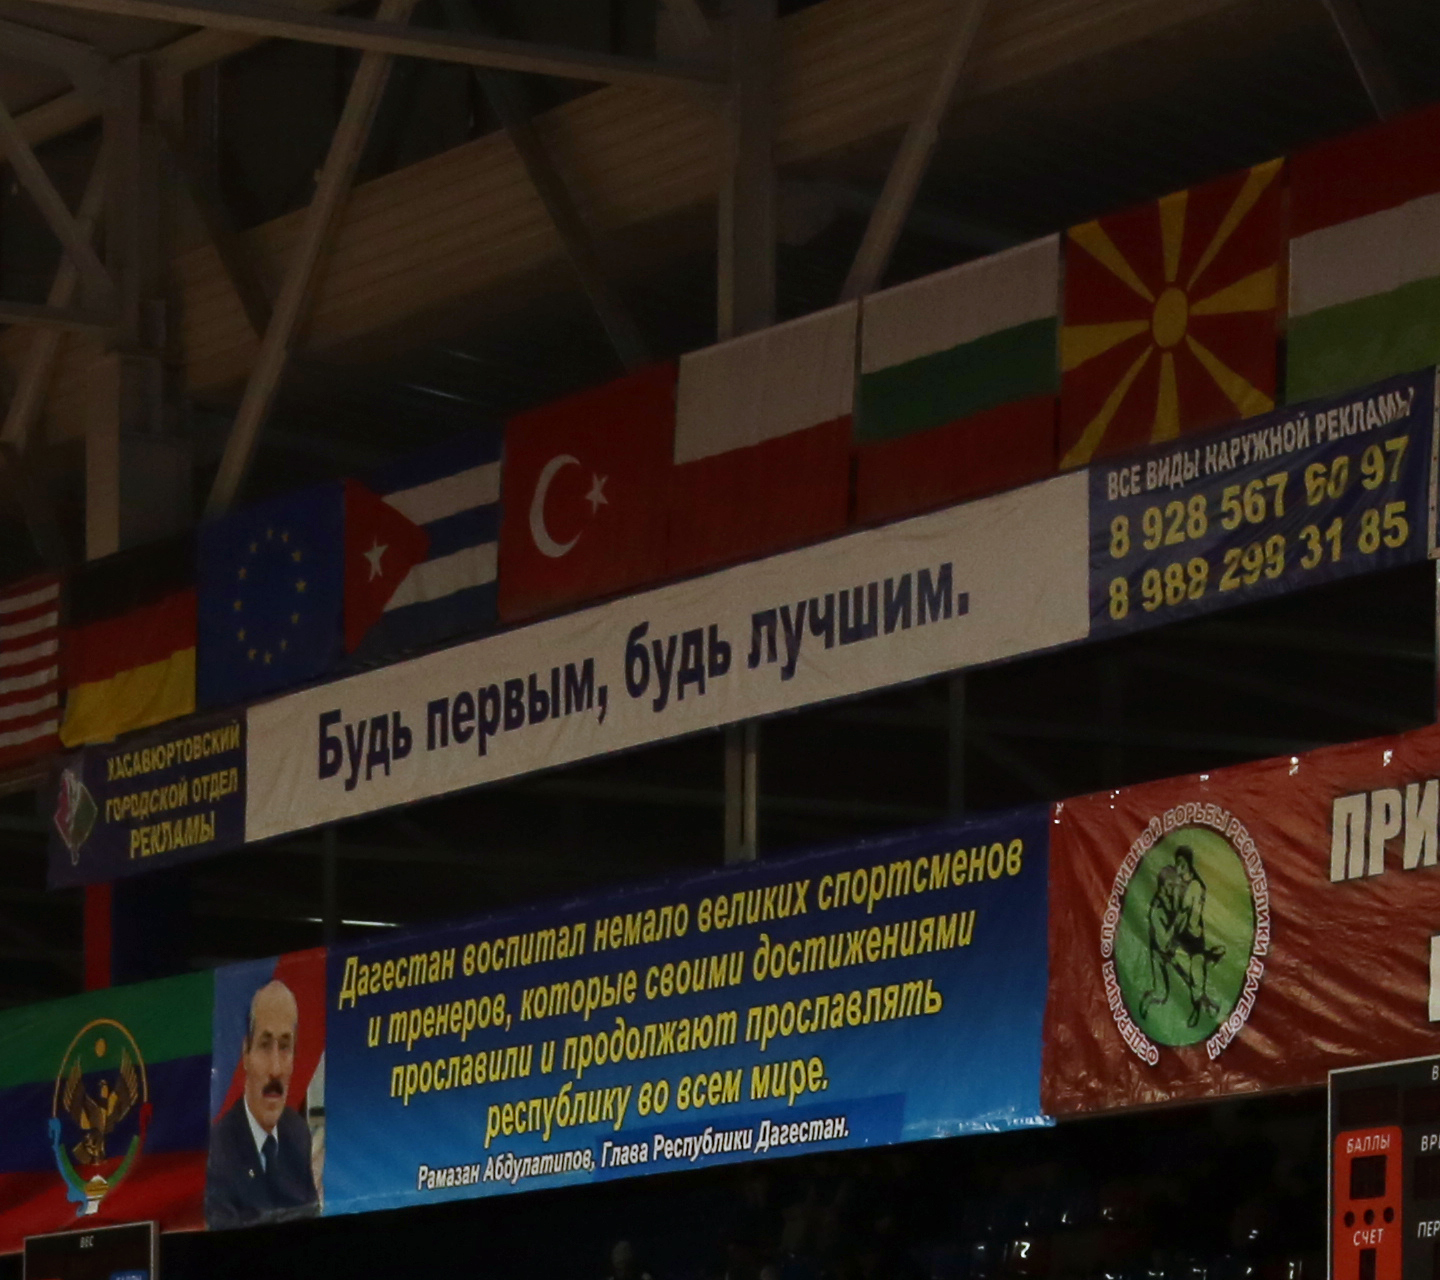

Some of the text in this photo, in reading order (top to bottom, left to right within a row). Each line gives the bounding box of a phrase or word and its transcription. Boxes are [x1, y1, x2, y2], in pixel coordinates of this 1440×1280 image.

[1108, 465, 1140, 501] ВСЕ
[1146, 449, 1200, 489] ВИДЫ
[1205, 412, 1310, 475] НАРУЖНОЙ
[1110, 515, 1130, 559] 8
[1142, 494, 1207, 550] 928
[1221, 472, 1289, 531] 567
[1361, 435, 1409, 490] 97
[1109, 501, 1408, 620] 8 988 299 31 85
[319, 562, 970, 791] Будь первым, будь лучшим.
[105, 767, 238, 824] ГОРОДСКОЙ ОТДЕЛ
[106, 719, 240, 782] ХАСАВЮРТОВСКИЙ
[130, 810, 215, 859] РЕКЛАМЫ
[339, 837, 1023, 1010] Дагестан воспитал немало великих спортсменов
[367, 909, 976, 1051] и тренеров, которые своими достижениями
[1207, 956, 1265, 1060] ДАГЕСТАН
[390, 978, 943, 1105] прославили и продолжают прославлять
[484, 1054, 829, 1148] республику во всем мире.
[1346, 1134, 1391, 1154] БАЛЛЫ
[417, 1114, 850, 1191] Рамазан Абдулатипов, Глава Республики Дагестан.
[1353, 1228, 1384, 1247] СЧЕТ
